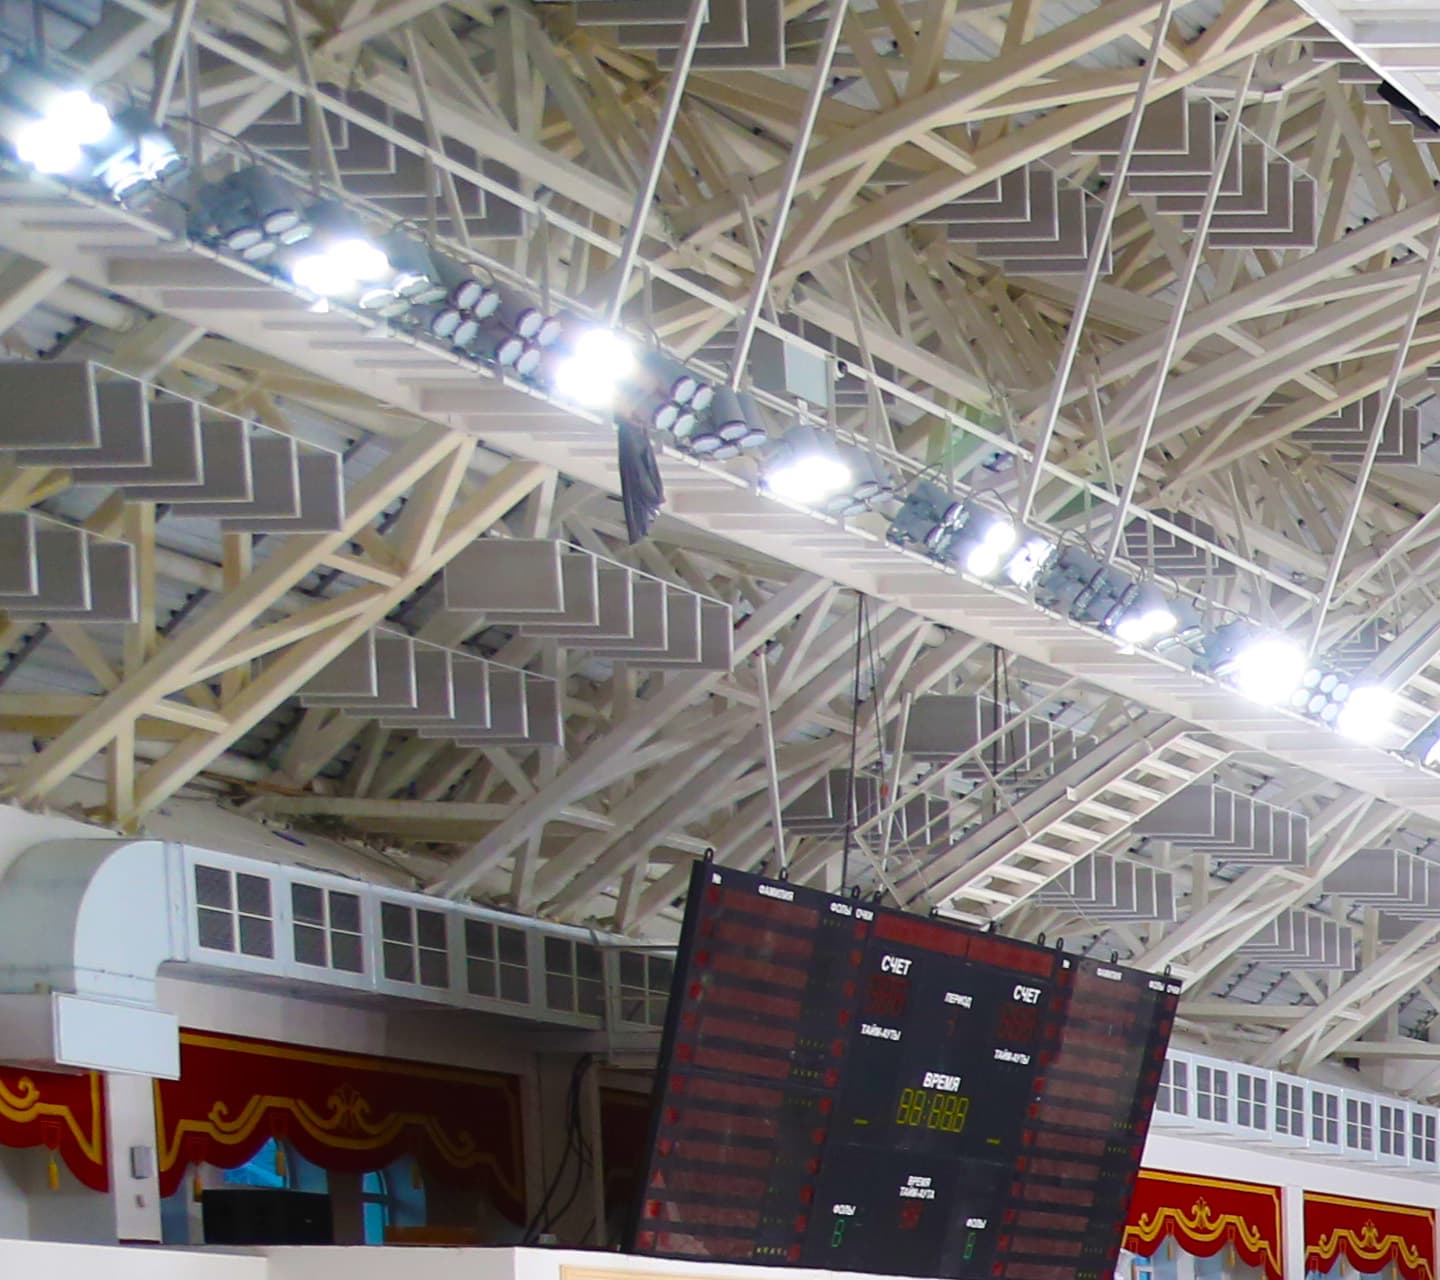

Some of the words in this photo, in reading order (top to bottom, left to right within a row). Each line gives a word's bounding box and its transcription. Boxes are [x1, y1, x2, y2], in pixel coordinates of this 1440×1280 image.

[881, 954, 912, 976] СЧЕТ
[1012, 984, 1041, 1005] СЧЕТ
[922, 1071, 962, 1092] ВРЕМЯ
